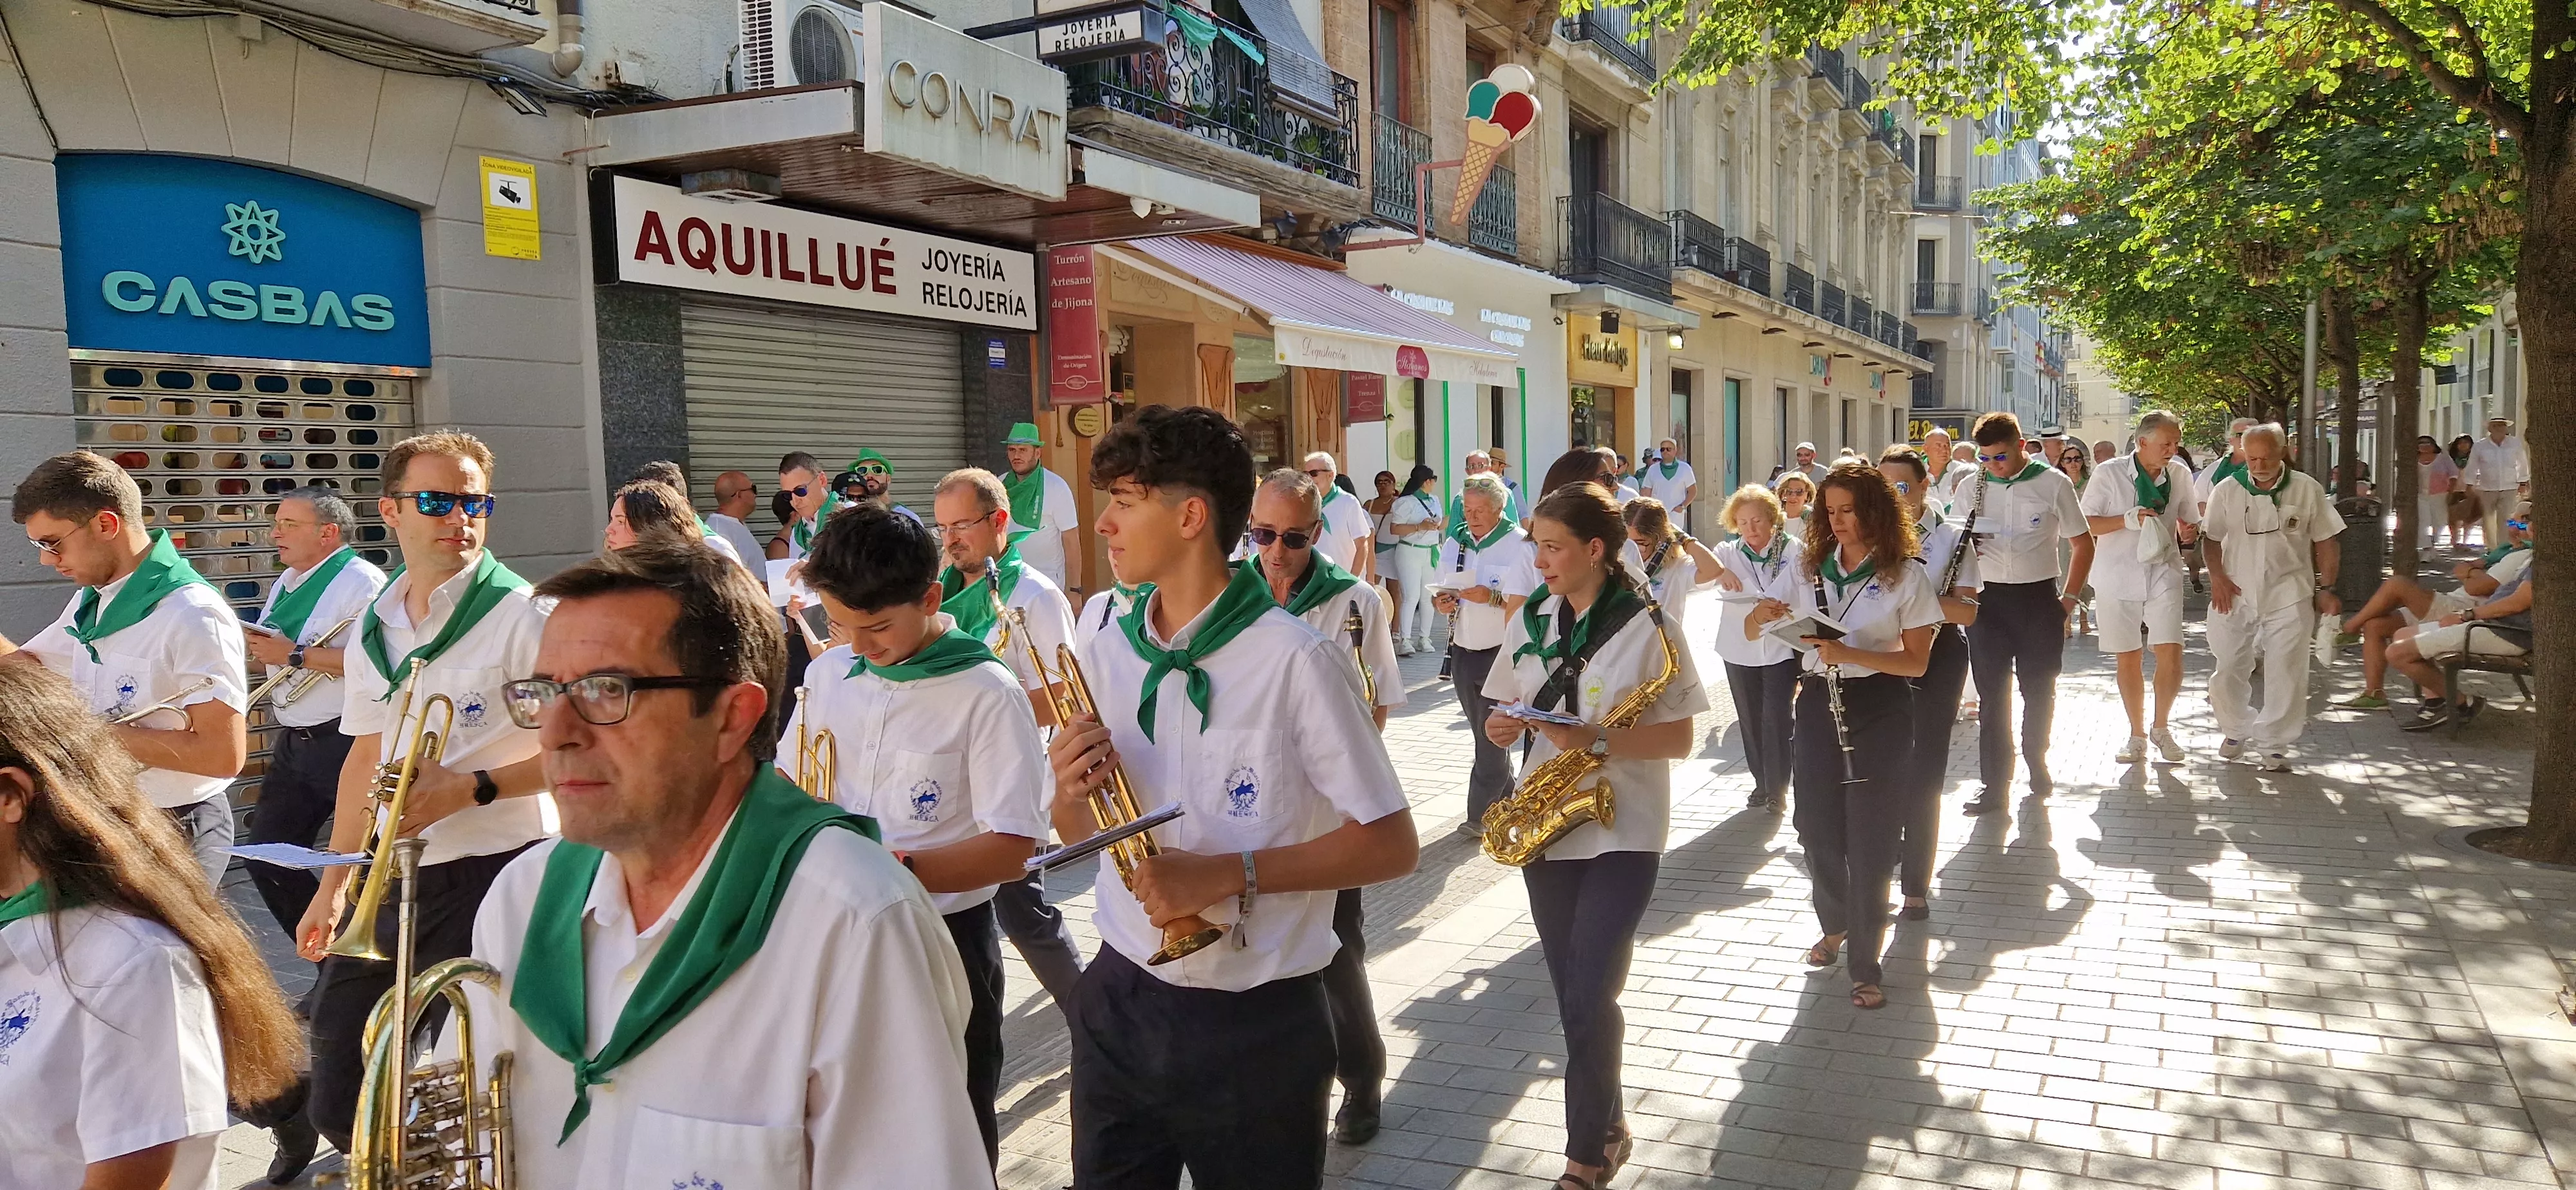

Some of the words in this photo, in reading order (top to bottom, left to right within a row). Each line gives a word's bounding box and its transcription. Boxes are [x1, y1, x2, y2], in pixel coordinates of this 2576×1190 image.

[889, 59, 1063, 154] CONRAT
[634, 210, 898, 296] AQUILLUÉ
[921, 247, 1006, 283] JOYERÍA
[1054, 253, 1085, 265] Turrón
[922, 281, 1028, 317] RELOJERÍA
[1050, 277, 1092, 287] Artesano
[102, 270, 395, 331] CASBAS
[1052, 299, 1063, 308] de
[1064, 297, 1093, 310] Jijona
[1302, 337, 1347, 361] Degustación
